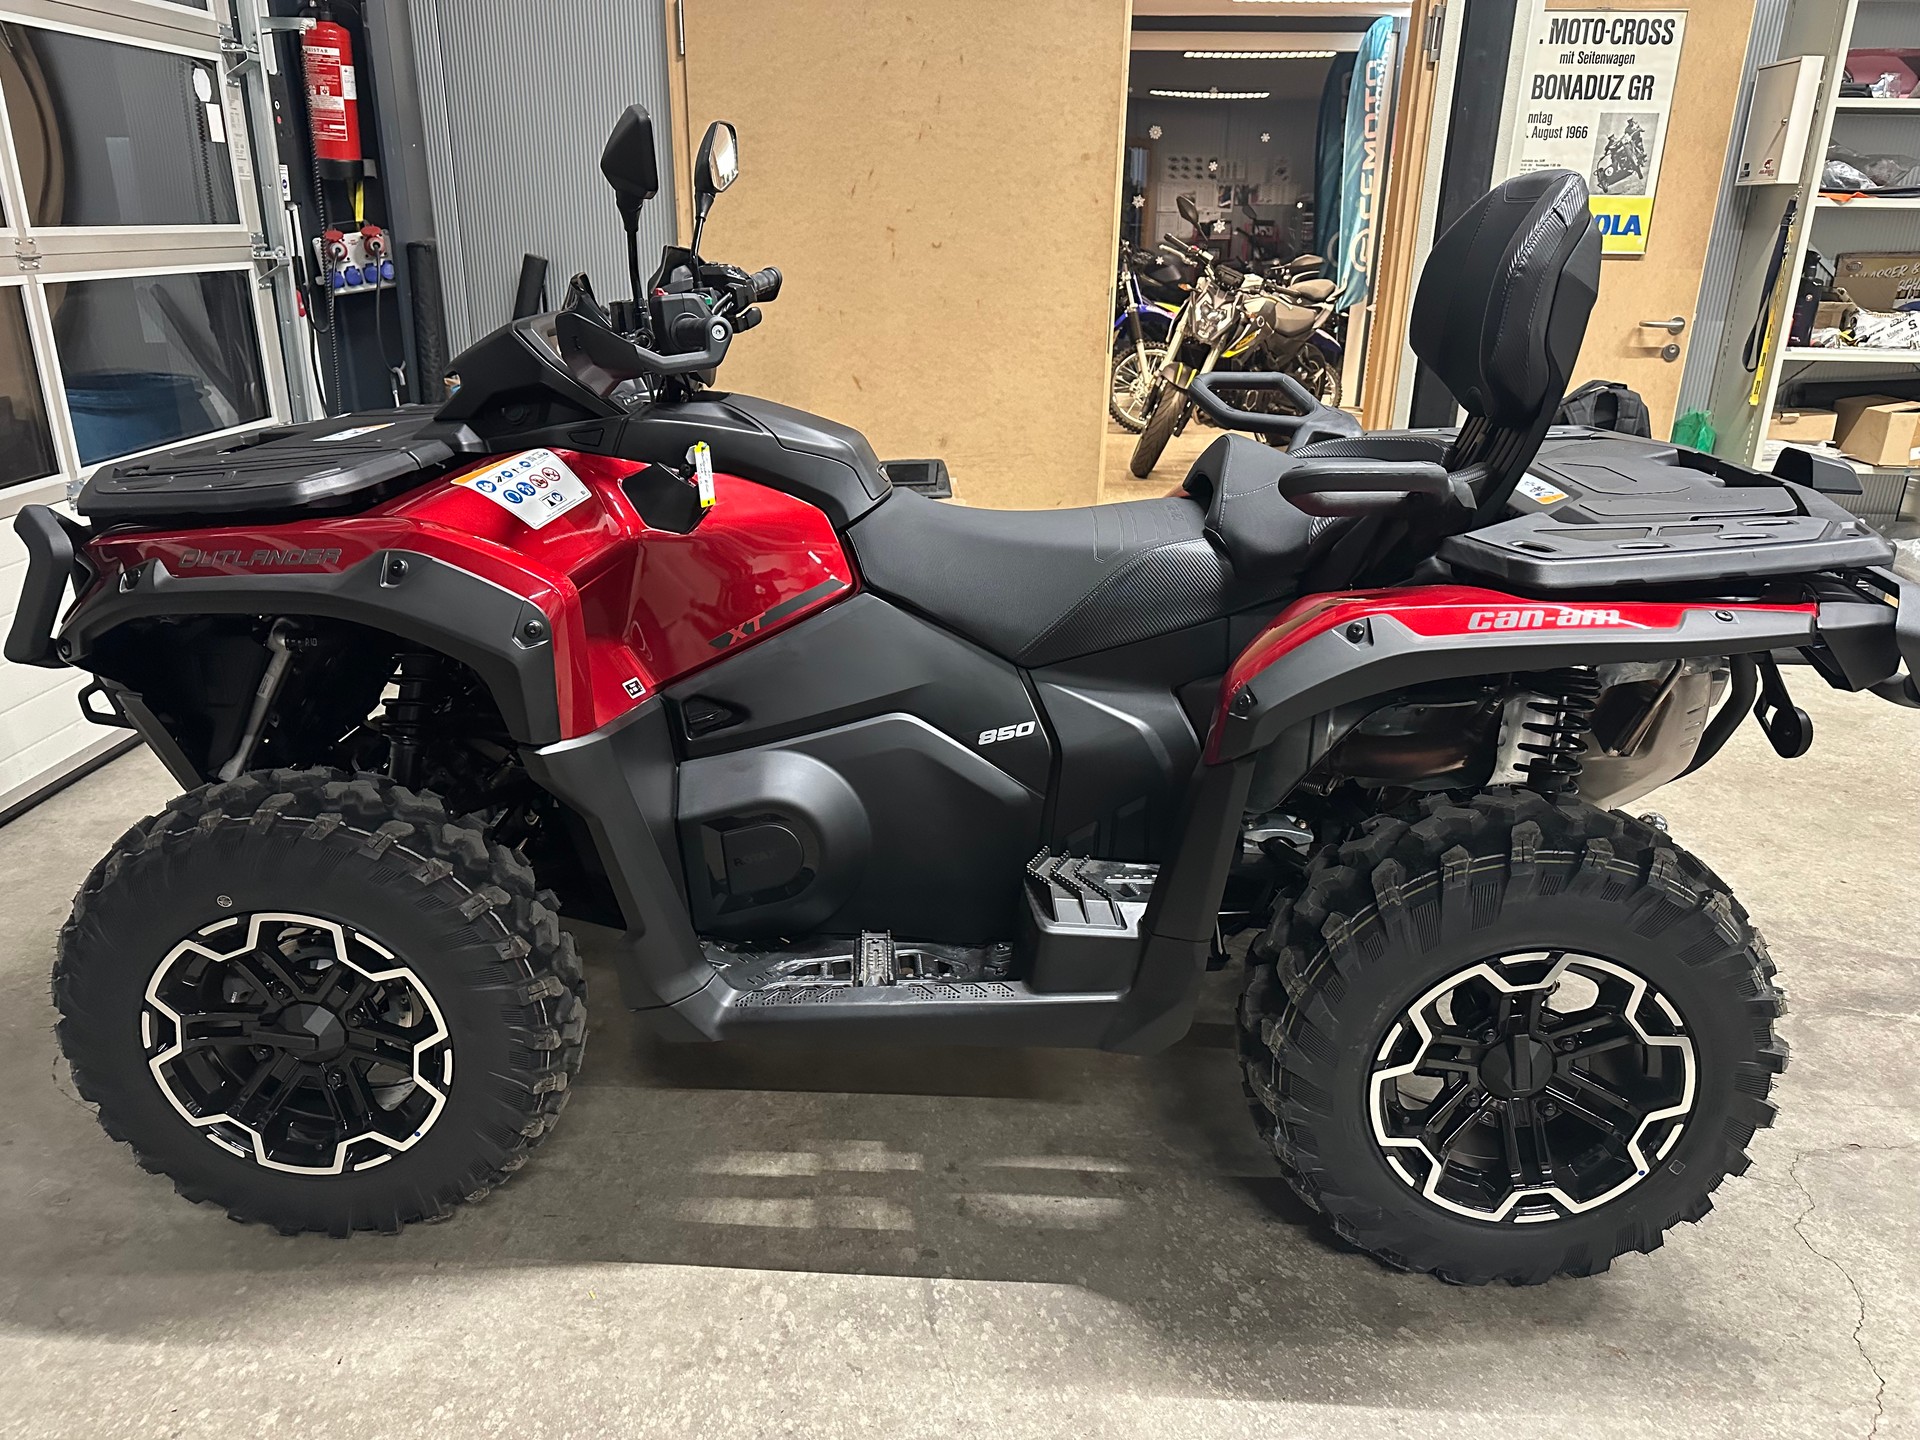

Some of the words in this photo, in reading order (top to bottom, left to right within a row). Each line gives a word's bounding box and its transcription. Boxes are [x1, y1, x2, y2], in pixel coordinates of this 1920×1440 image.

[1549, 18, 1675, 45] MOTO-CROSS
[1559, 51, 1575, 65] mit
[1577, 51, 1636, 67] Seitenwagen
[1531, 74, 1625, 101] BONADUZ
[1627, 74, 1655, 101] GR
[1531, 126, 1563, 141] August
[1565, 125, 1588, 139] 1966
[177, 548, 343, 569] OUTLANDER
[727, 611, 766, 645] XT
[977, 720, 1036, 746] 850
